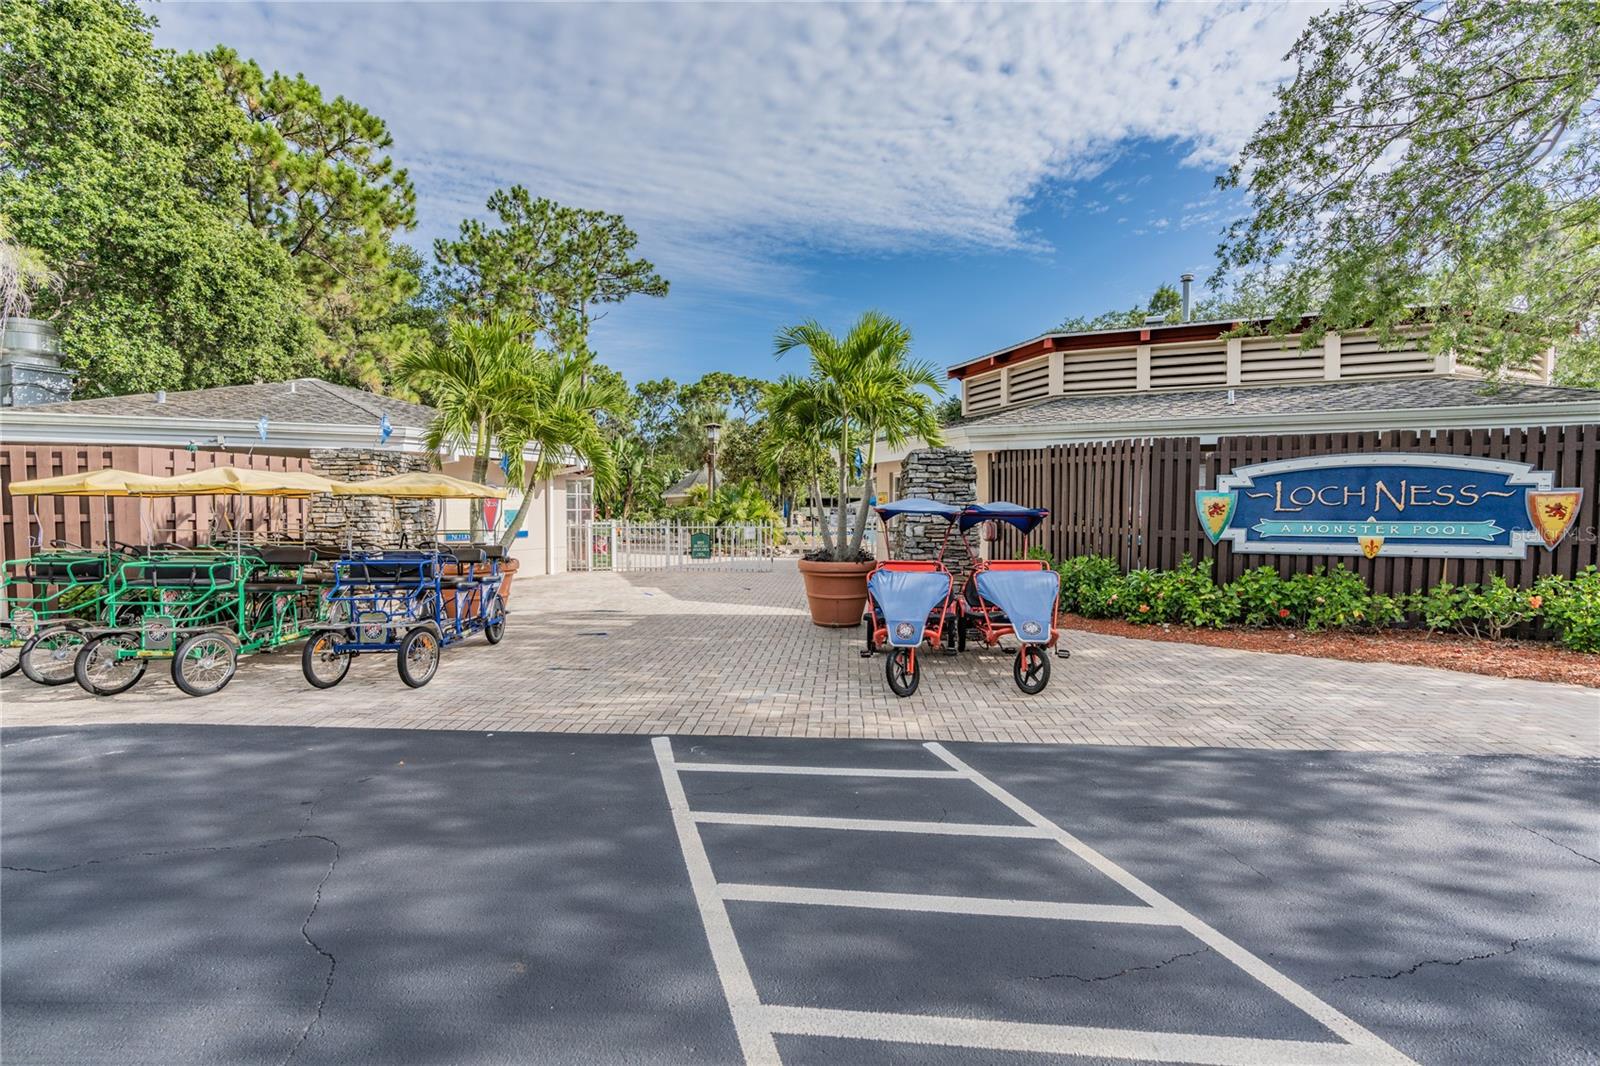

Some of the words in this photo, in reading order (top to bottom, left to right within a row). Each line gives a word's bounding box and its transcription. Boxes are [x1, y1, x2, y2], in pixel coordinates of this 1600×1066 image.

[1274, 480, 1366, 512] LOCH
[1374, 479, 1480, 512] NESS
[1281, 524, 1292, 533] A
[1302, 524, 1400, 534] MONSTER
[1413, 525, 1470, 535] POOL
